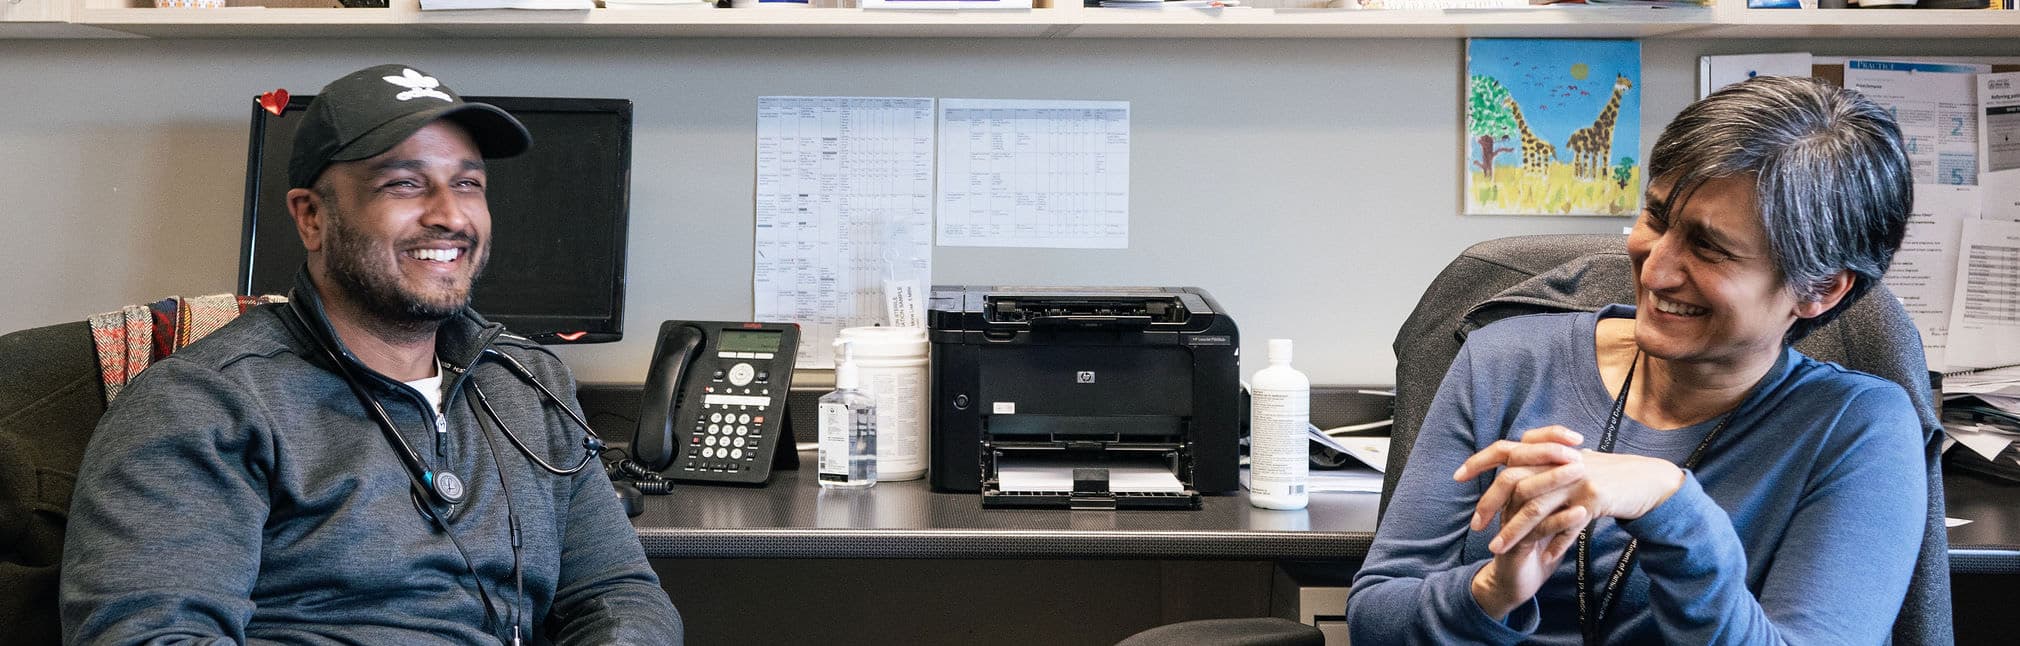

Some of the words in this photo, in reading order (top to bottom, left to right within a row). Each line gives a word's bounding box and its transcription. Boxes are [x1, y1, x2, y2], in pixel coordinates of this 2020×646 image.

[1951, 118, 1963, 136] 2
[1907, 136, 1918, 154] 4
[1951, 168, 1963, 185] 5
[1601, 422, 1617, 450] Property
[1611, 416, 1618, 425] of
